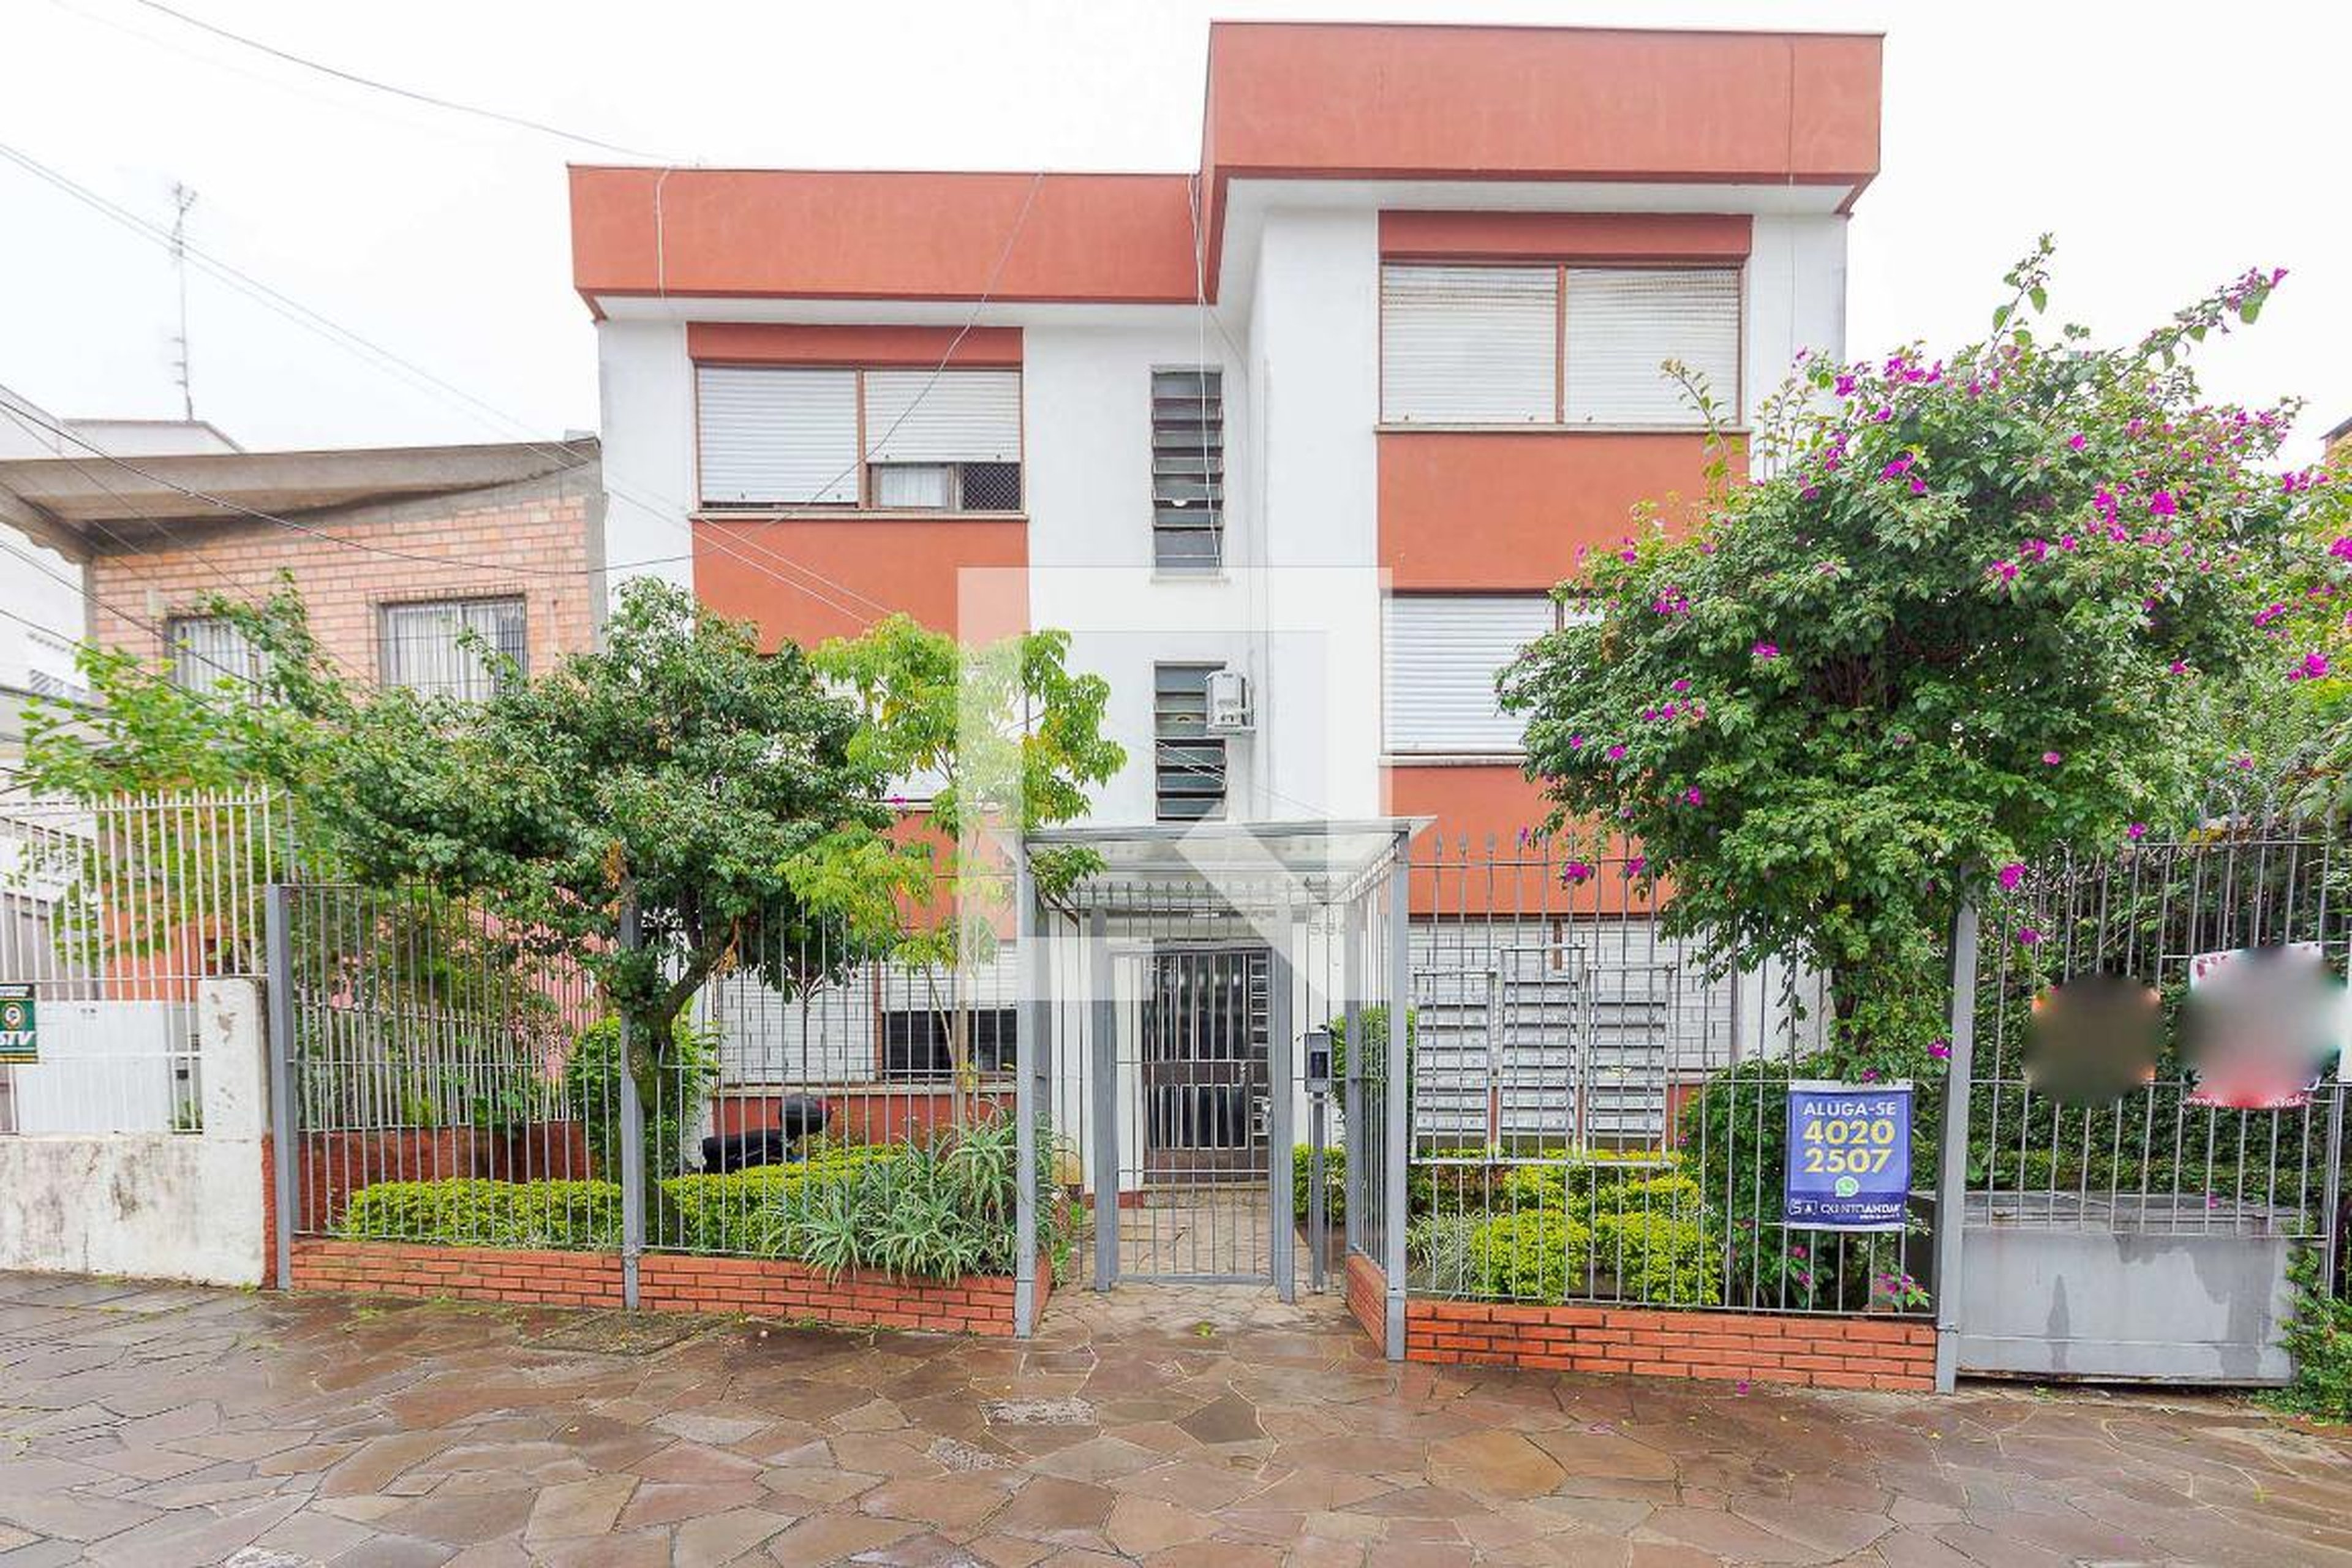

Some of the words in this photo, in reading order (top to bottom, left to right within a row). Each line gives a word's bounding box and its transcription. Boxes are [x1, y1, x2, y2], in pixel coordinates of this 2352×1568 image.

[1803, 1101, 1896, 1116] ALUGA-SE
[1803, 1118, 1896, 1145] 4020
[1804, 1147, 1893, 1174] 2507
